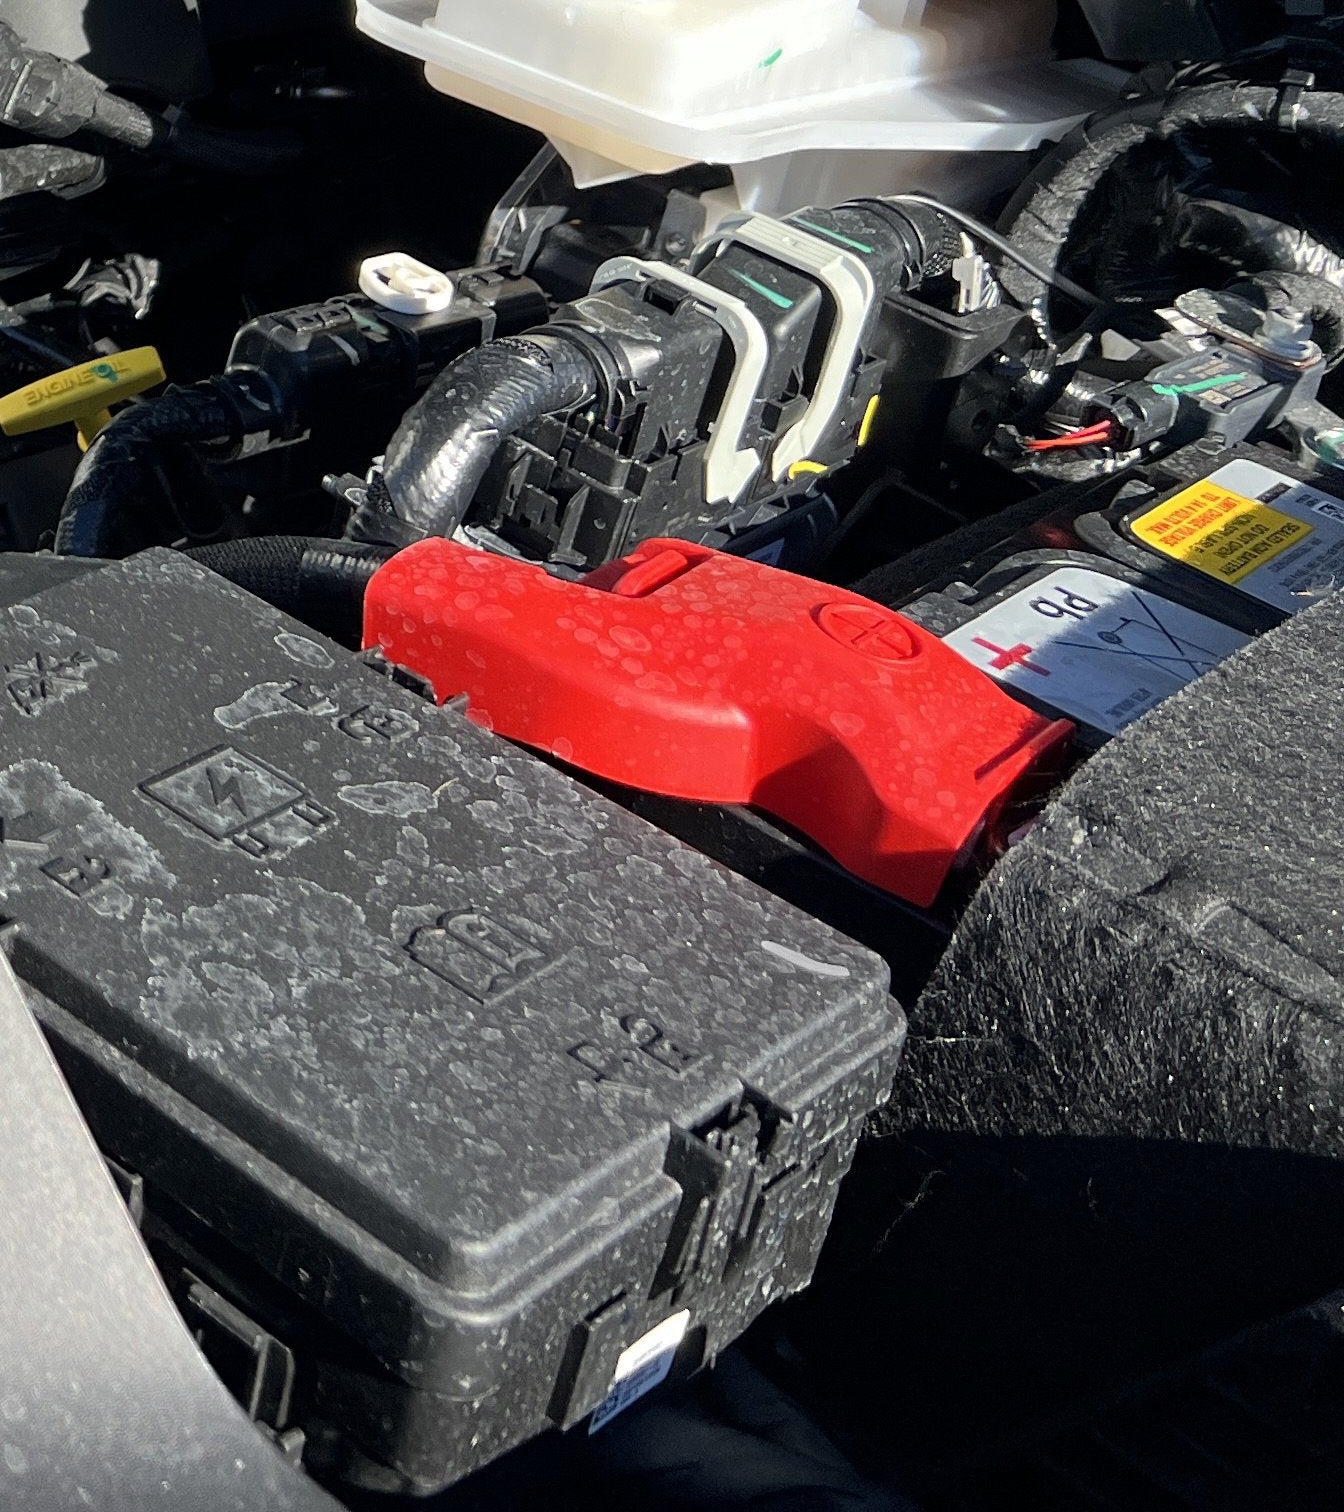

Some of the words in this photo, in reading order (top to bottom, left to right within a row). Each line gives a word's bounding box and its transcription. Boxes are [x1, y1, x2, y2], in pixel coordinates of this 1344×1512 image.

[23, 368, 98, 407] ENGINE
[94, 360, 131, 381] OIL
[1029, 585, 1099, 621] Pb
